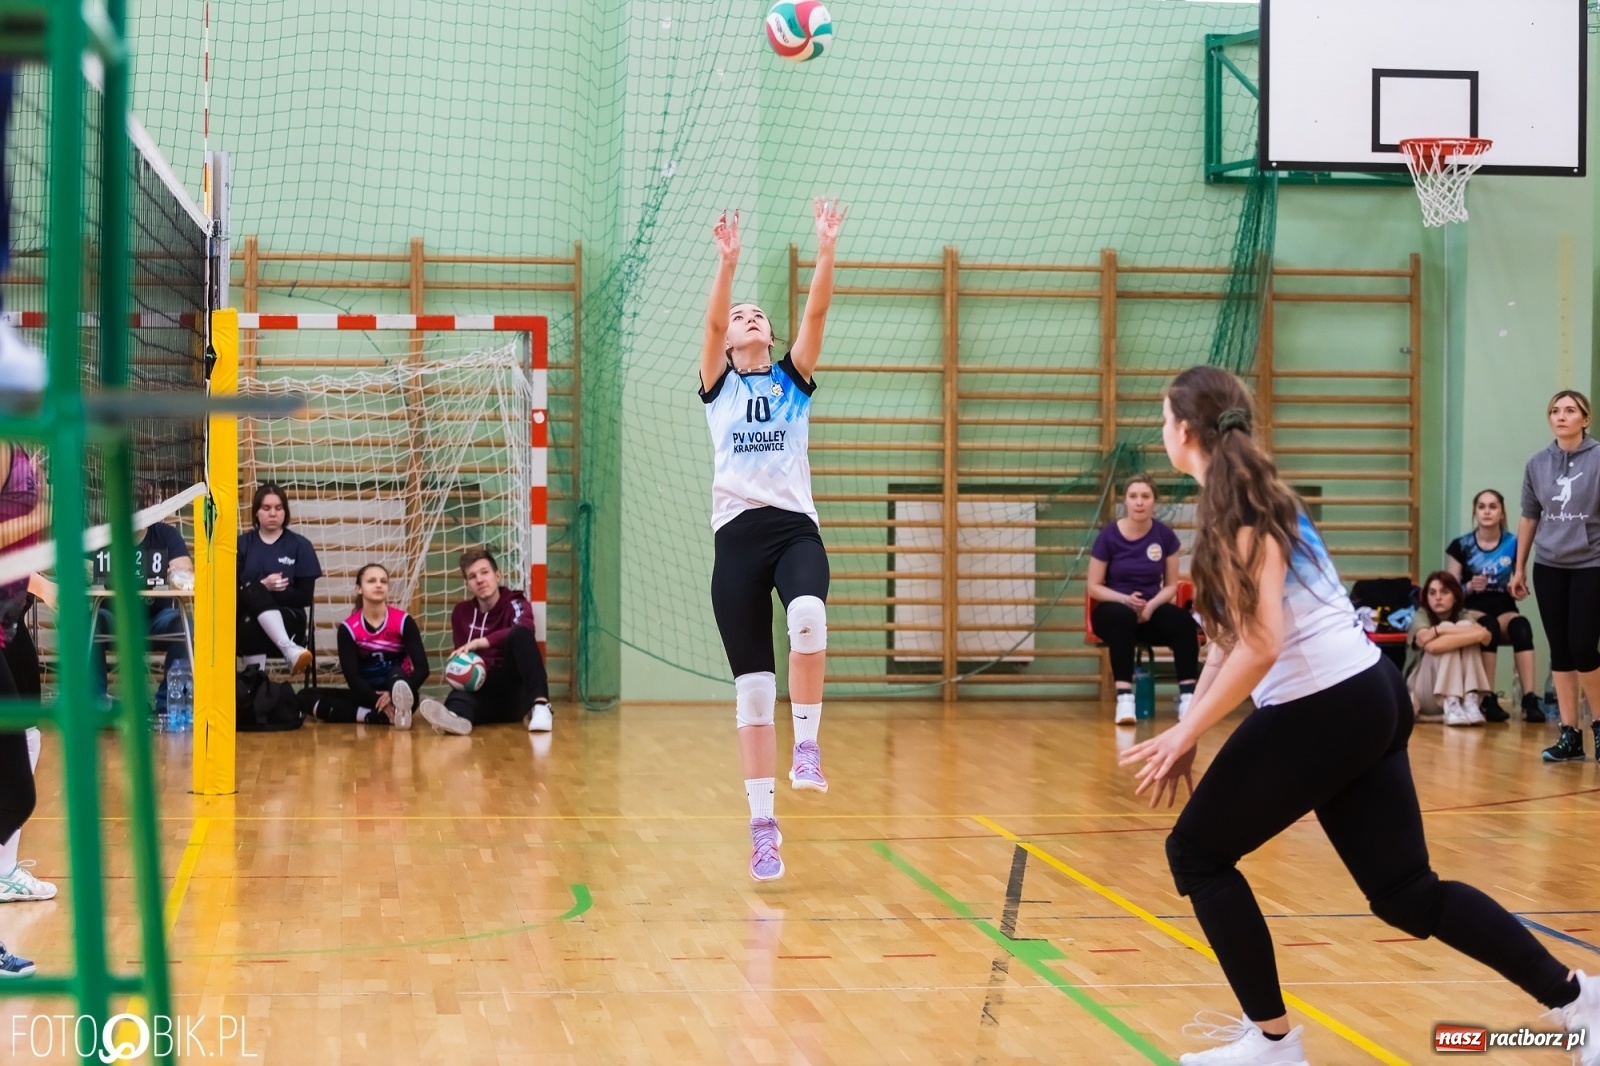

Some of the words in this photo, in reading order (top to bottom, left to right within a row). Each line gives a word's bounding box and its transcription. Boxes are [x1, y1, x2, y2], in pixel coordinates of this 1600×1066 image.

[746, 396, 771, 423] 10
[732, 432, 745, 444] PV
[748, 430, 787, 443] VOLLEY
[733, 442, 785, 454] KRAPKOWICE
[96, 550, 111, 572] 11
[152, 552, 162, 573] 8
